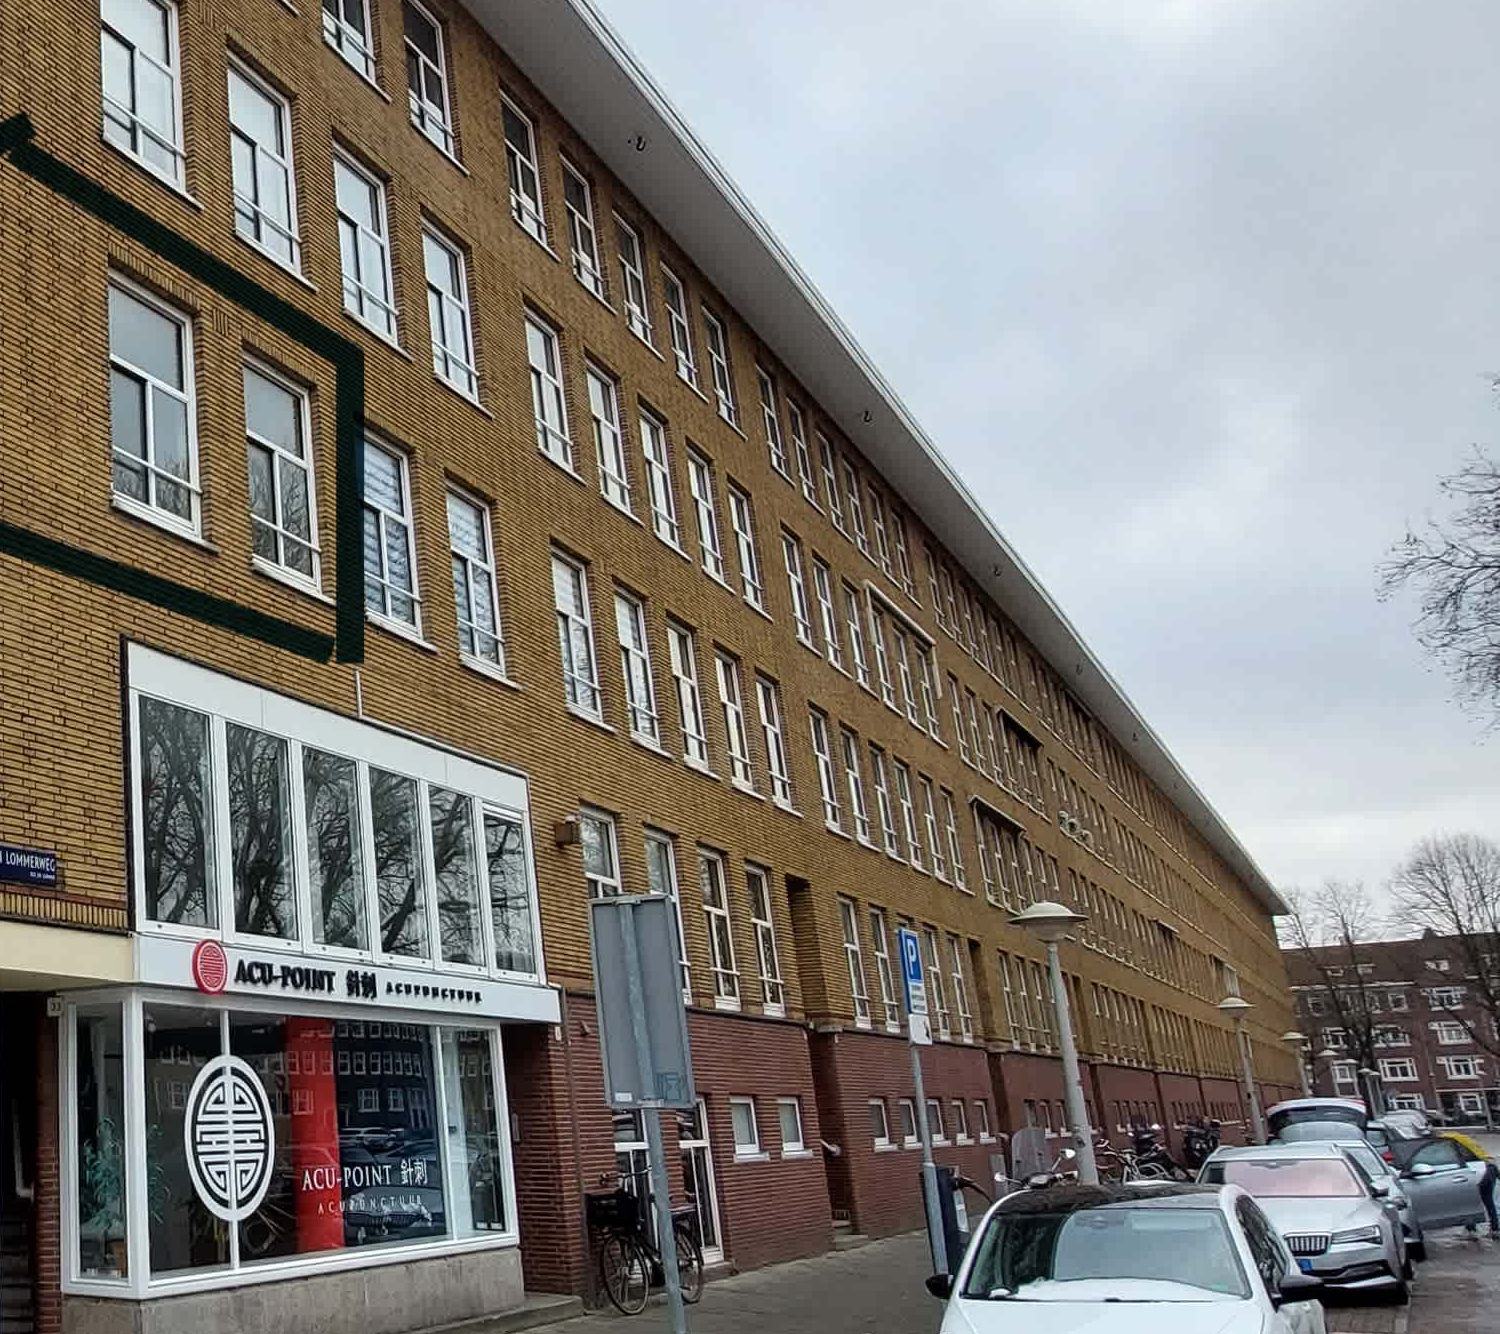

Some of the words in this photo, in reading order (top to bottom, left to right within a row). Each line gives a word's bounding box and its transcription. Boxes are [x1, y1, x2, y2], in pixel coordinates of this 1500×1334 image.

[5, 850, 56, 873] LOMMERWEG
[906, 938, 917, 976] P
[234, 959, 336, 994] ACU-POINT
[302, 1165, 392, 1191] ACU-POINT
[400, 1156, 428, 1186] 針刺
